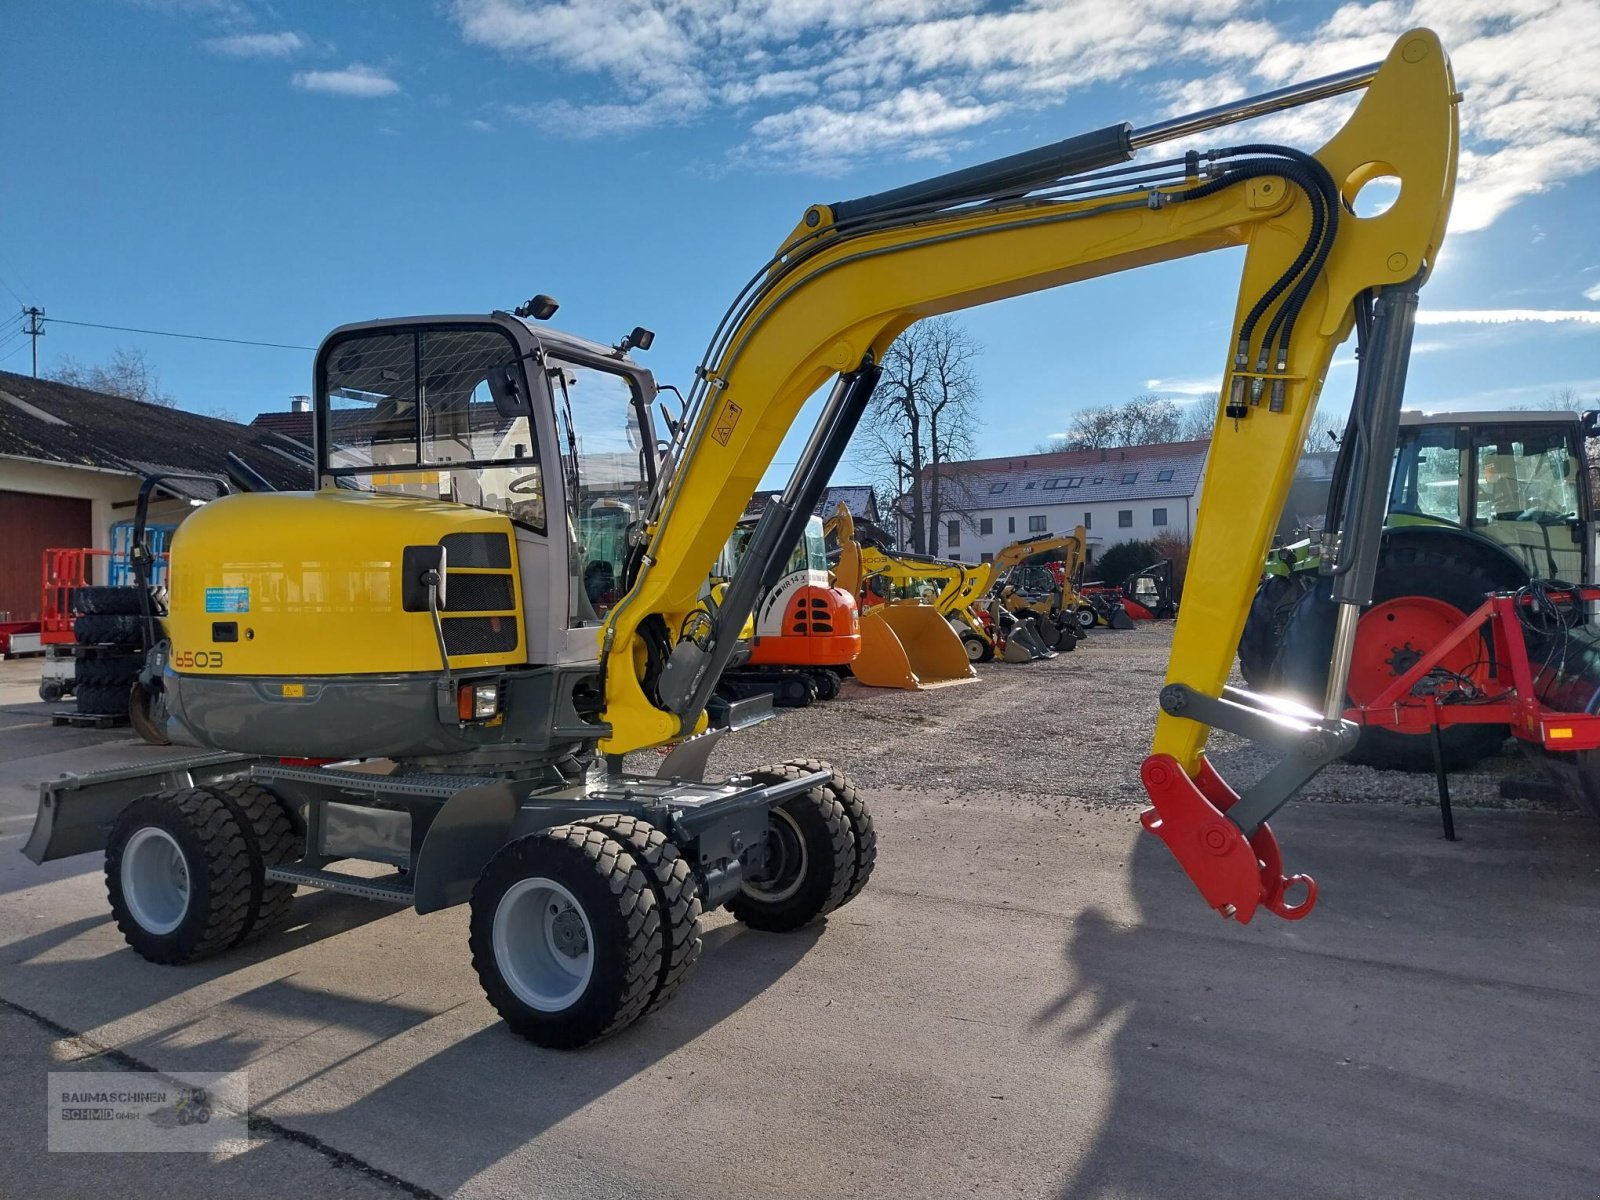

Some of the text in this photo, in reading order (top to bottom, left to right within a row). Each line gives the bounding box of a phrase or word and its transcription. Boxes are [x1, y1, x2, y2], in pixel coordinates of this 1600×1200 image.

[781, 575, 799, 590] HR 14
[176, 651, 223, 668] 6503
